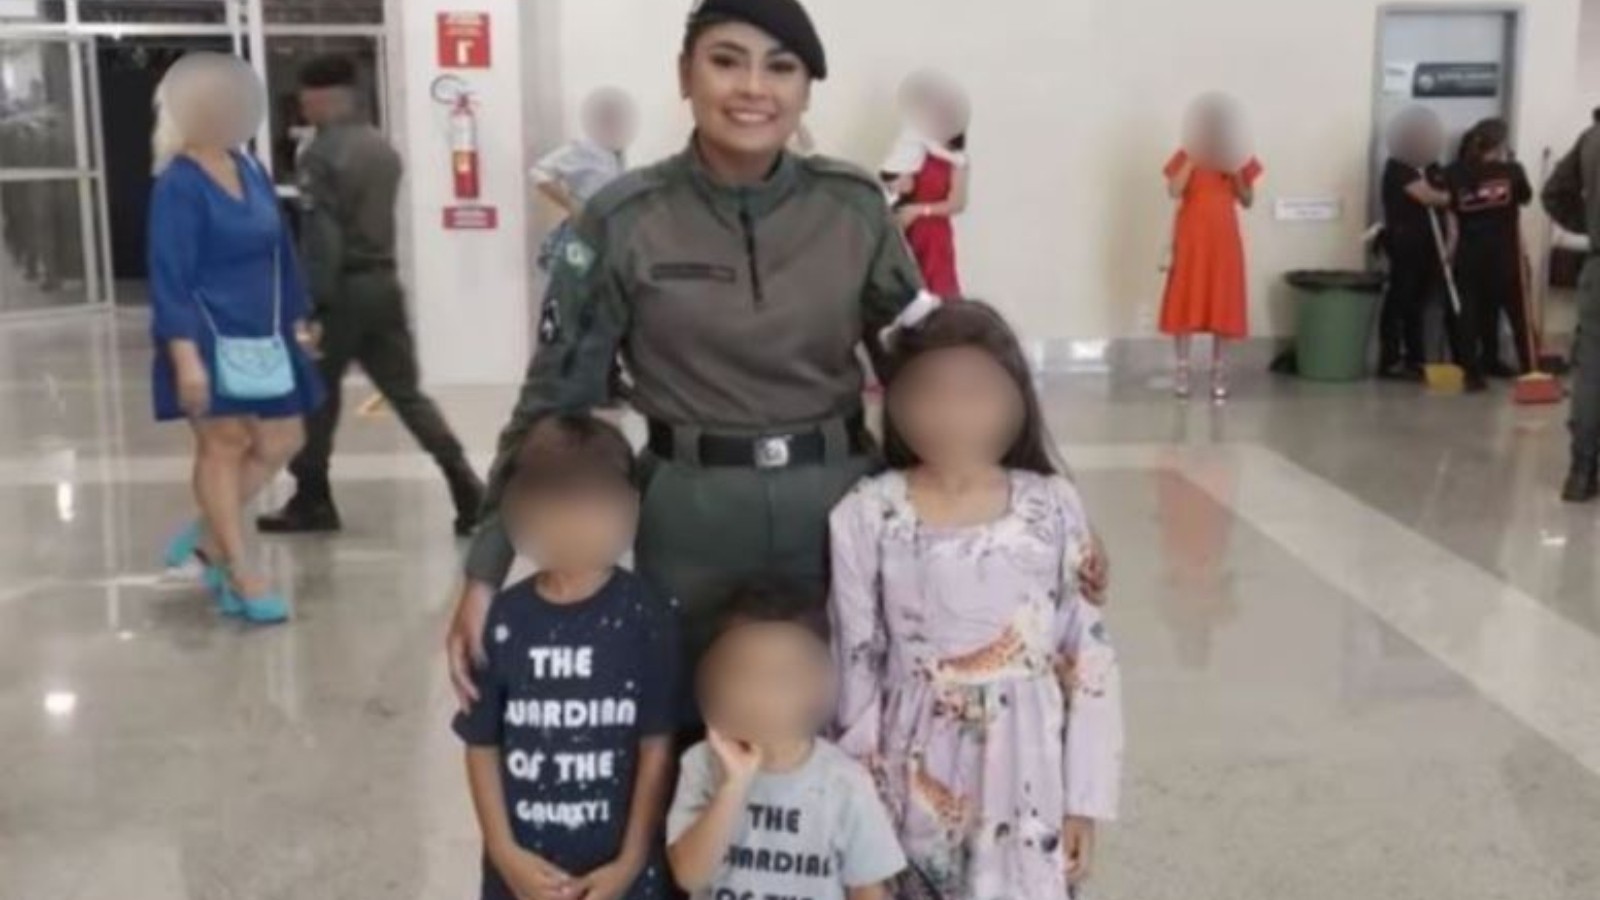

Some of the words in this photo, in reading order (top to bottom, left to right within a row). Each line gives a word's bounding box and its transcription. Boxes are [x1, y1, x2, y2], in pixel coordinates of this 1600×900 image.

[529, 646, 593, 677] THE
[505, 698, 636, 726] UARDIAN
[508, 751, 544, 780] OF
[554, 751, 613, 780] THE
[747, 804, 801, 833] THE
